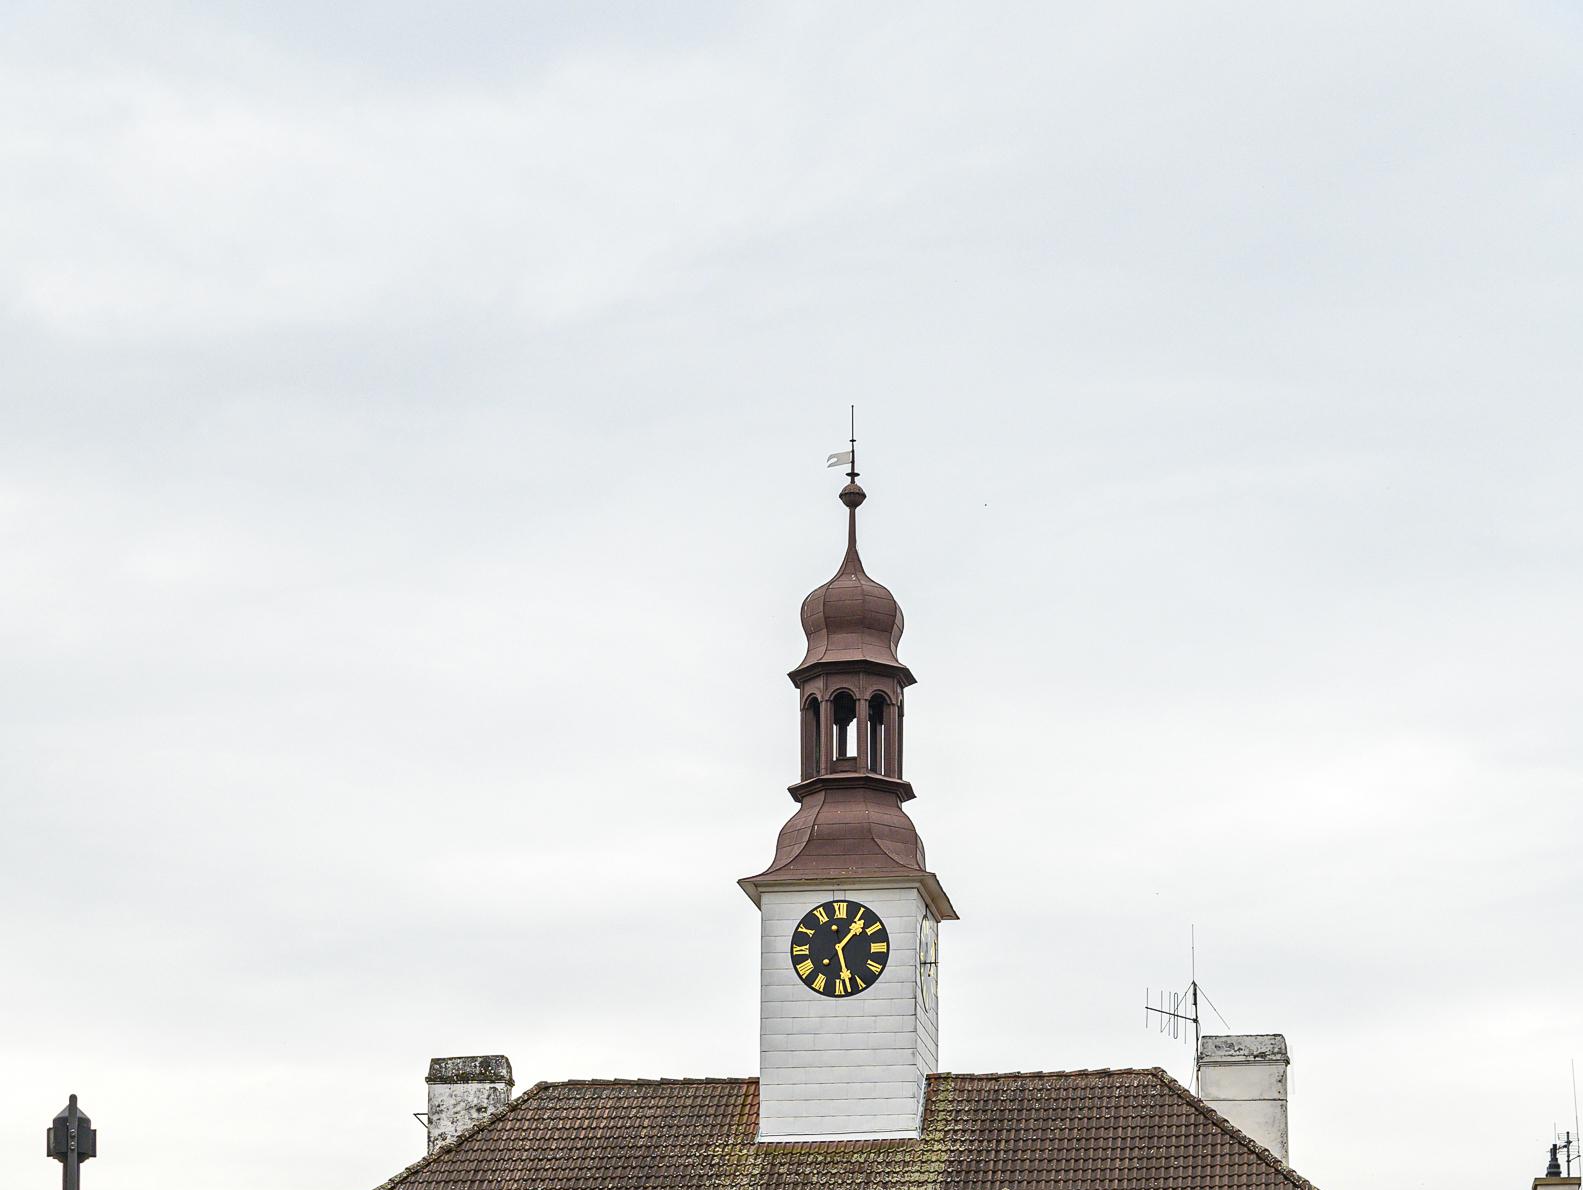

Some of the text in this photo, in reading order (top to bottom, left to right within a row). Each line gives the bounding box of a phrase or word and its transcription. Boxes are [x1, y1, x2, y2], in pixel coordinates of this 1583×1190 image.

[813, 907, 829, 925] XI
[833, 903, 848, 919] XII
[797, 924, 815, 938] X
[865, 922, 882, 936] II
[793, 944, 809, 956] IX
[870, 942, 887, 954] III
[796, 958, 814, 979] VIII
[866, 960, 883, 976] IV
[812, 973, 827, 992] VII
